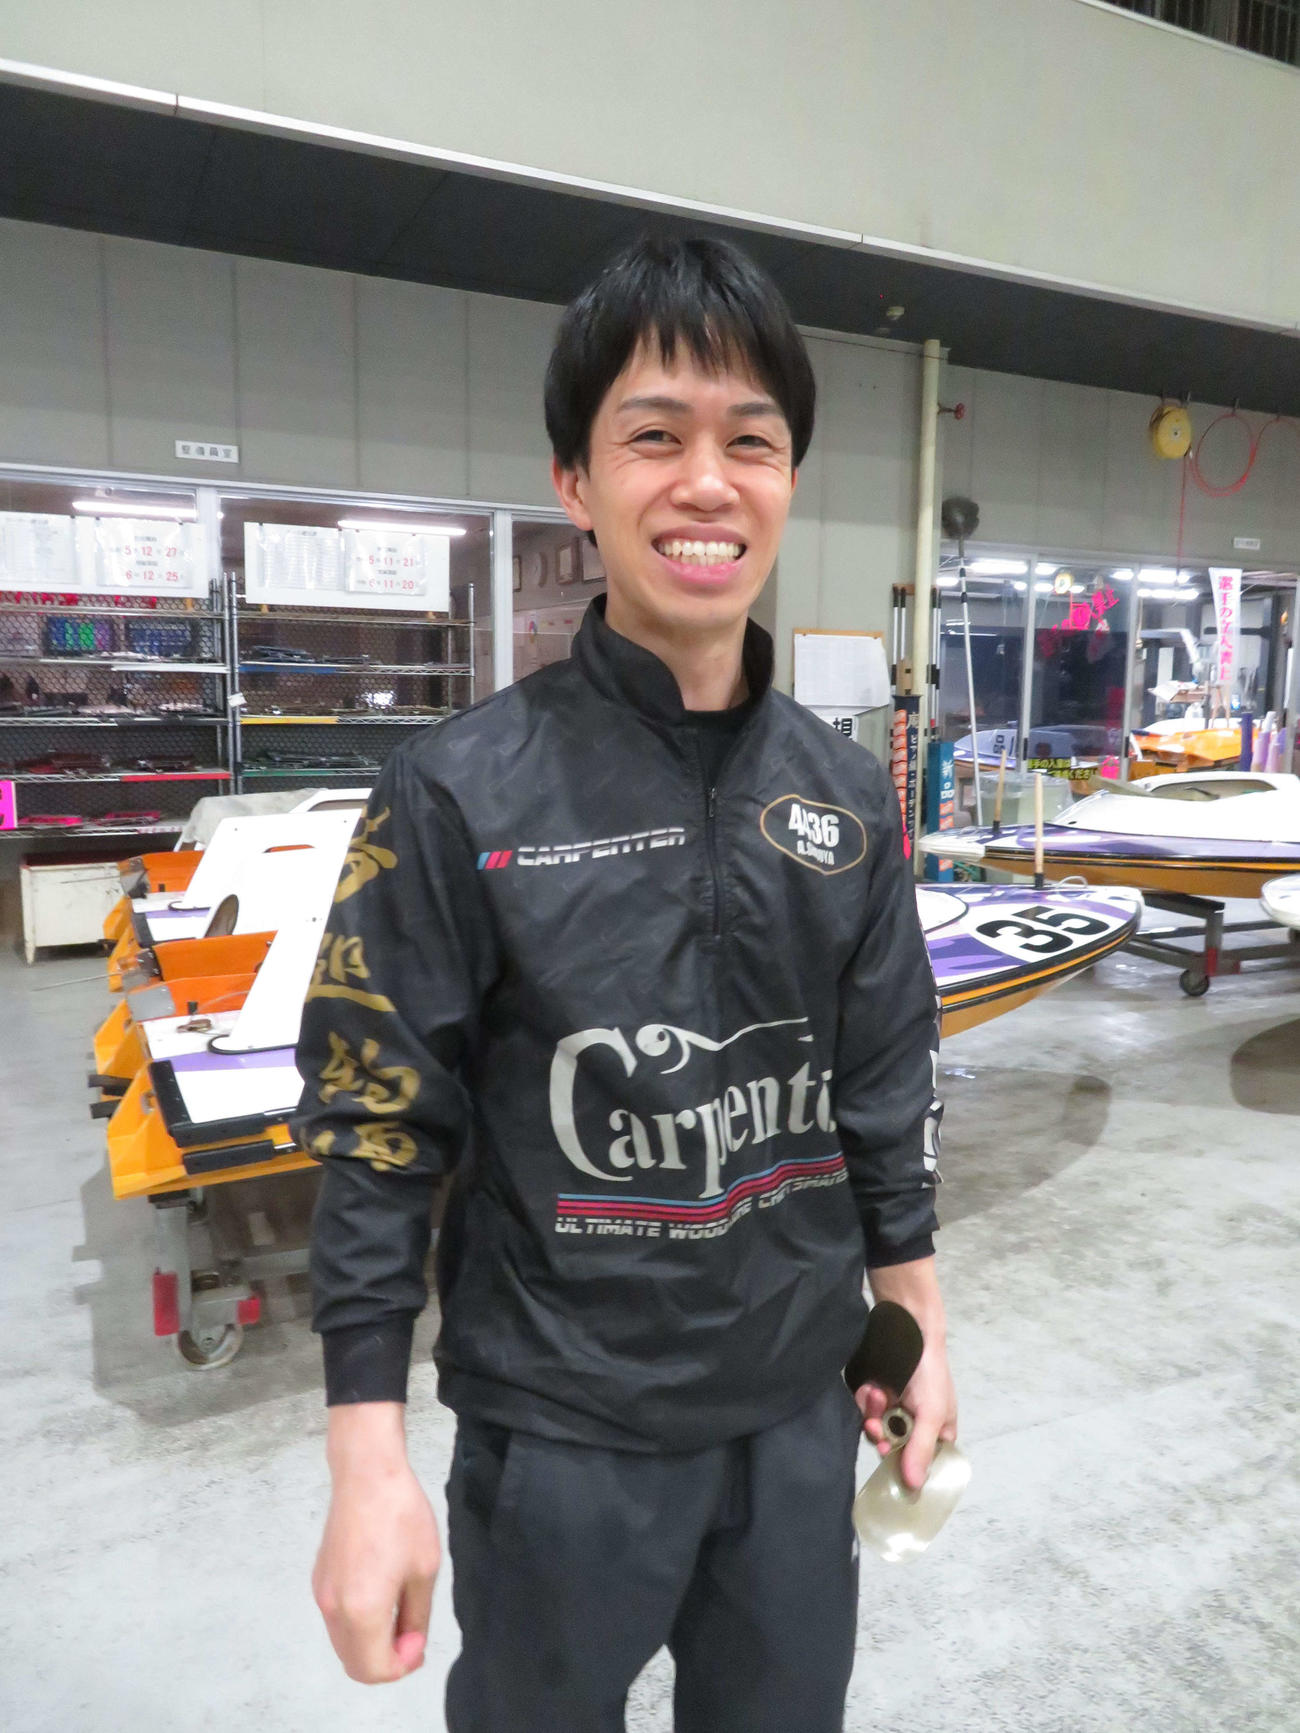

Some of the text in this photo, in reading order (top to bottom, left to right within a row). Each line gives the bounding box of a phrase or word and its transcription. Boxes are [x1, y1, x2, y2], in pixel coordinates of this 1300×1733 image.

[788, 803, 840, 848] 4436
[976, 905, 1110, 954] 35
[555, 1216, 662, 1238] ULTIMATE
